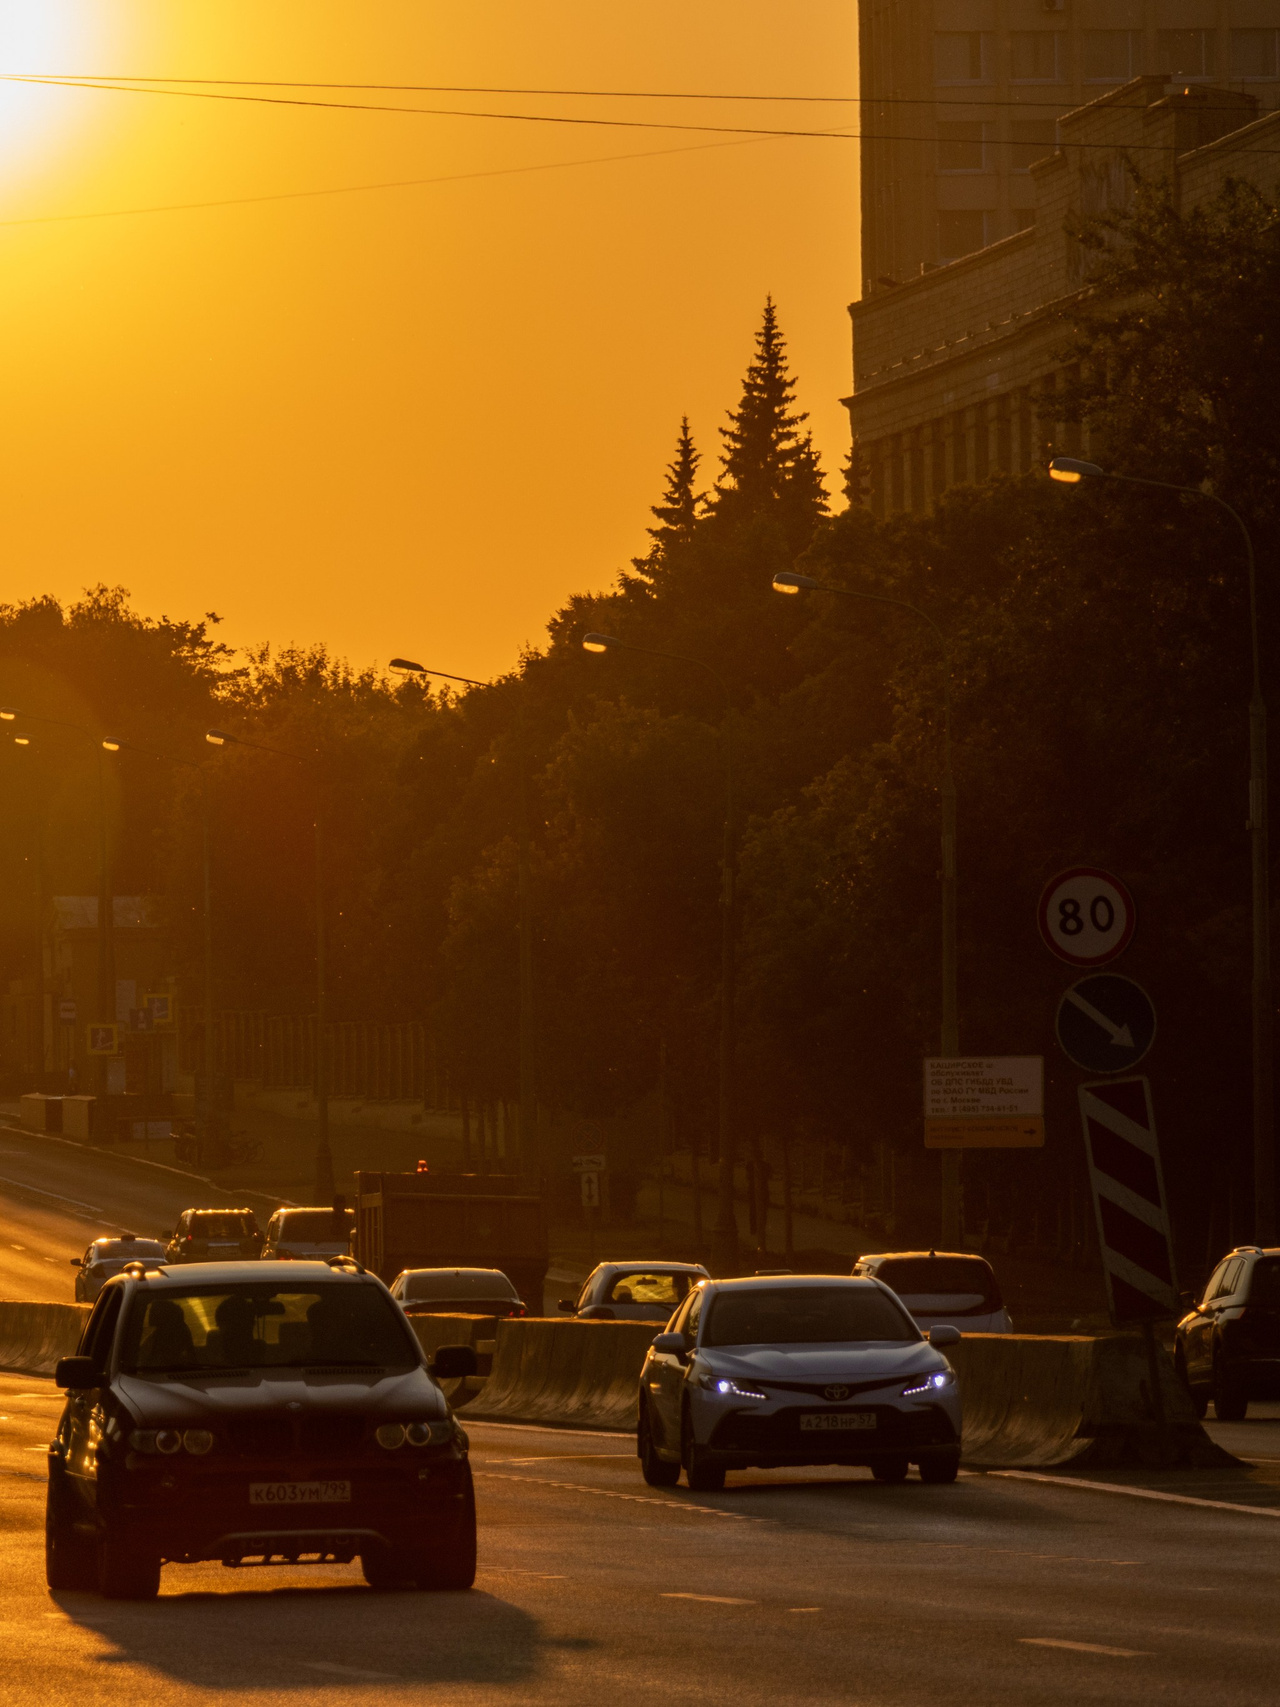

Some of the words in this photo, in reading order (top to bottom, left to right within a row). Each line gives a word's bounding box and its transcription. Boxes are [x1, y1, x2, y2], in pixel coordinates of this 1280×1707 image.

[1058, 896, 1114, 935] 80
[930, 1062, 984, 1070] КАШИРСКОЕ
[930, 1070, 984, 1078] обслуживает
[945, 1078, 963, 1086] ДПС
[965, 1078, 994, 1087] ГИБДД
[996, 1078, 1013, 1087] УВД
[943, 1087, 964, 1095] ЮАО
[966, 1087, 977, 1095] ГУ
[978, 1087, 997, 1096] МВД
[998, 1087, 1029, 1095] России
[959, 1105, 980, 1113] (495)
[859, 1415, 873, 1424] 57
[254, 1485, 320, 1502] К603УМ
[321, 1482, 347, 1495] 799
